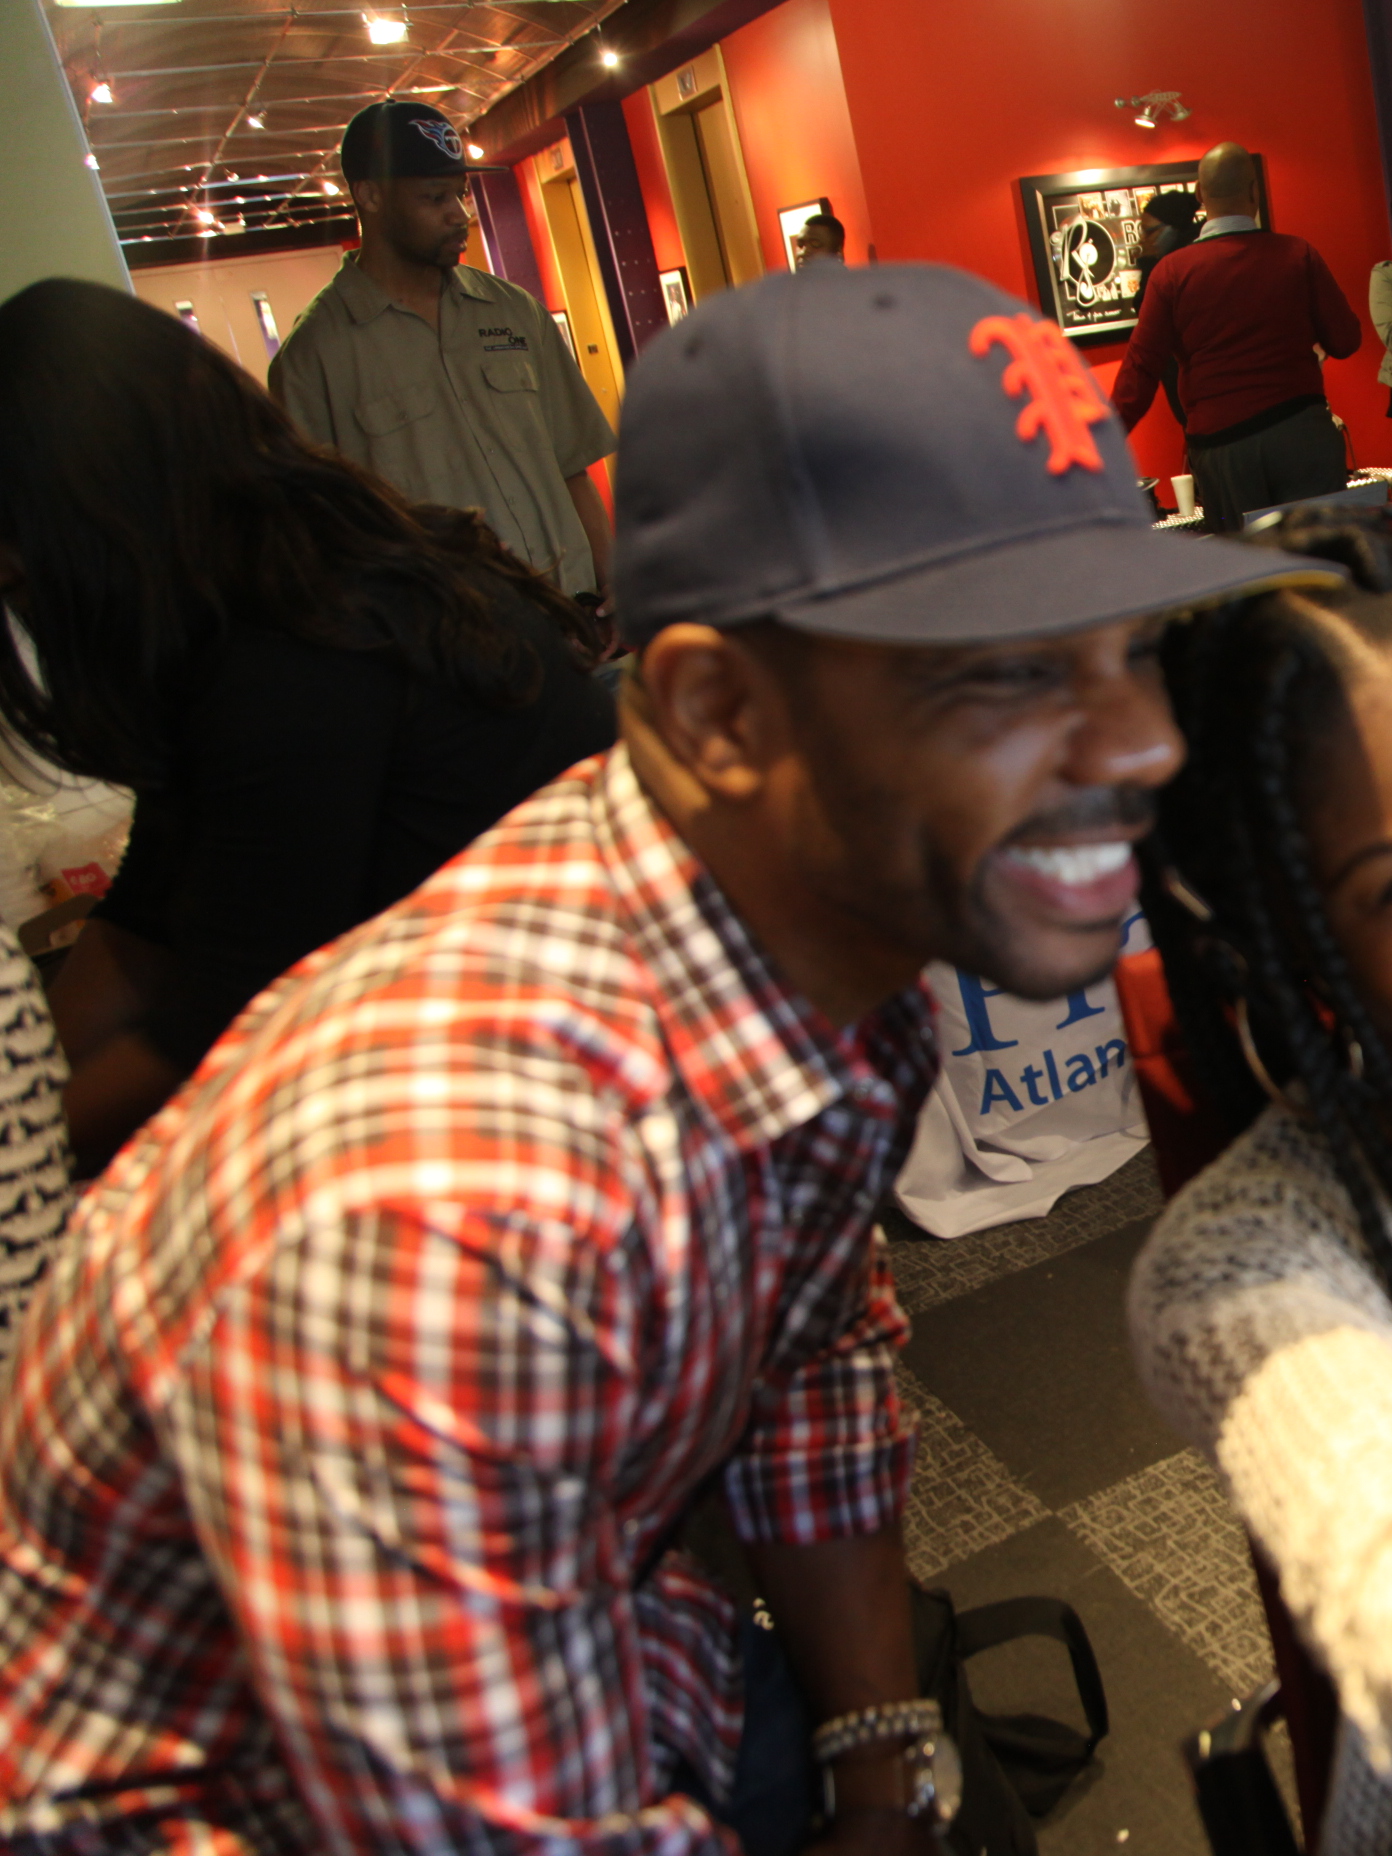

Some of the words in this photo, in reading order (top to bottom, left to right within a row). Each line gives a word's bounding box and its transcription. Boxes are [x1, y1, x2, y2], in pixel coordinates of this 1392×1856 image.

[478, 327, 512, 338] RADIO
[508, 336, 526, 345] ONE
[980, 1038, 1127, 1116] Atlan
